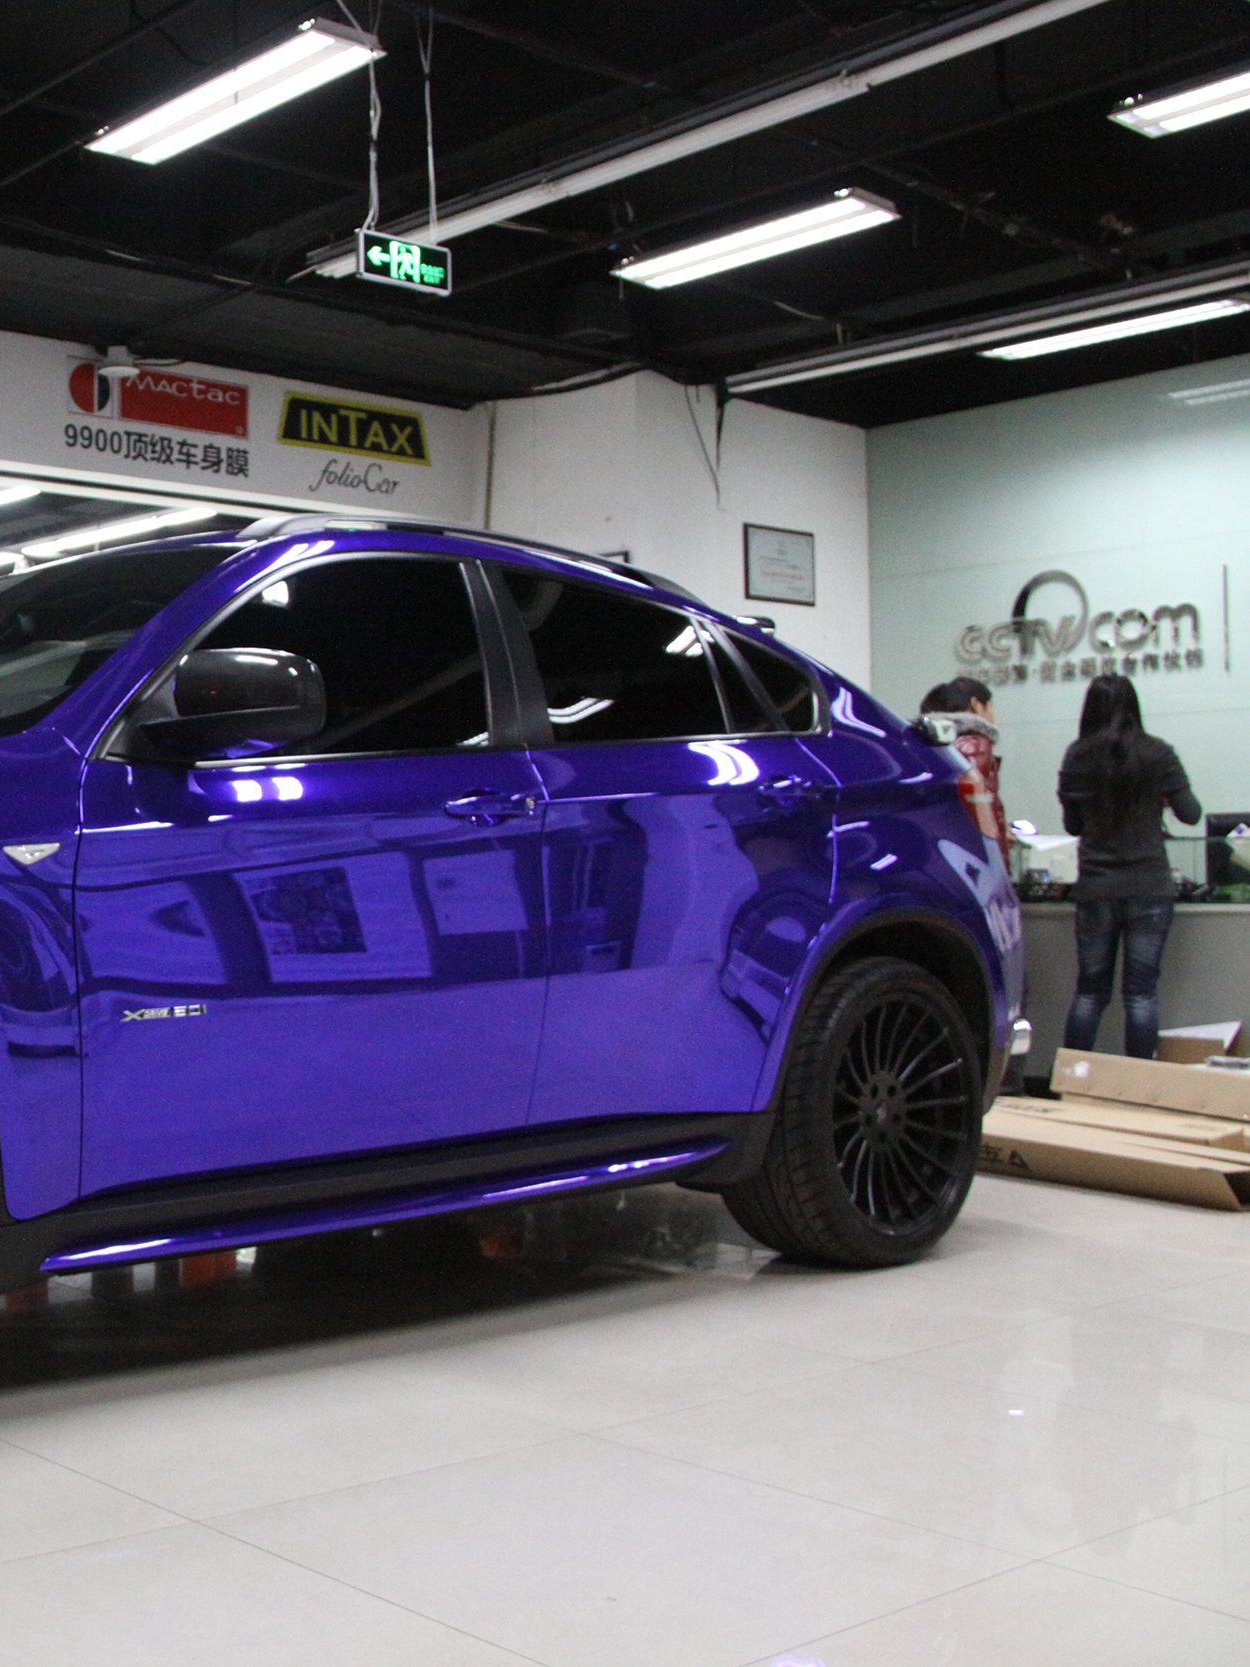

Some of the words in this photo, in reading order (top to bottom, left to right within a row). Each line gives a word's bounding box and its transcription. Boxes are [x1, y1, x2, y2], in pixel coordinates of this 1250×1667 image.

[64, 423, 249, 477] 9900顶级车身膜
[309, 458, 399, 494] folioCar
